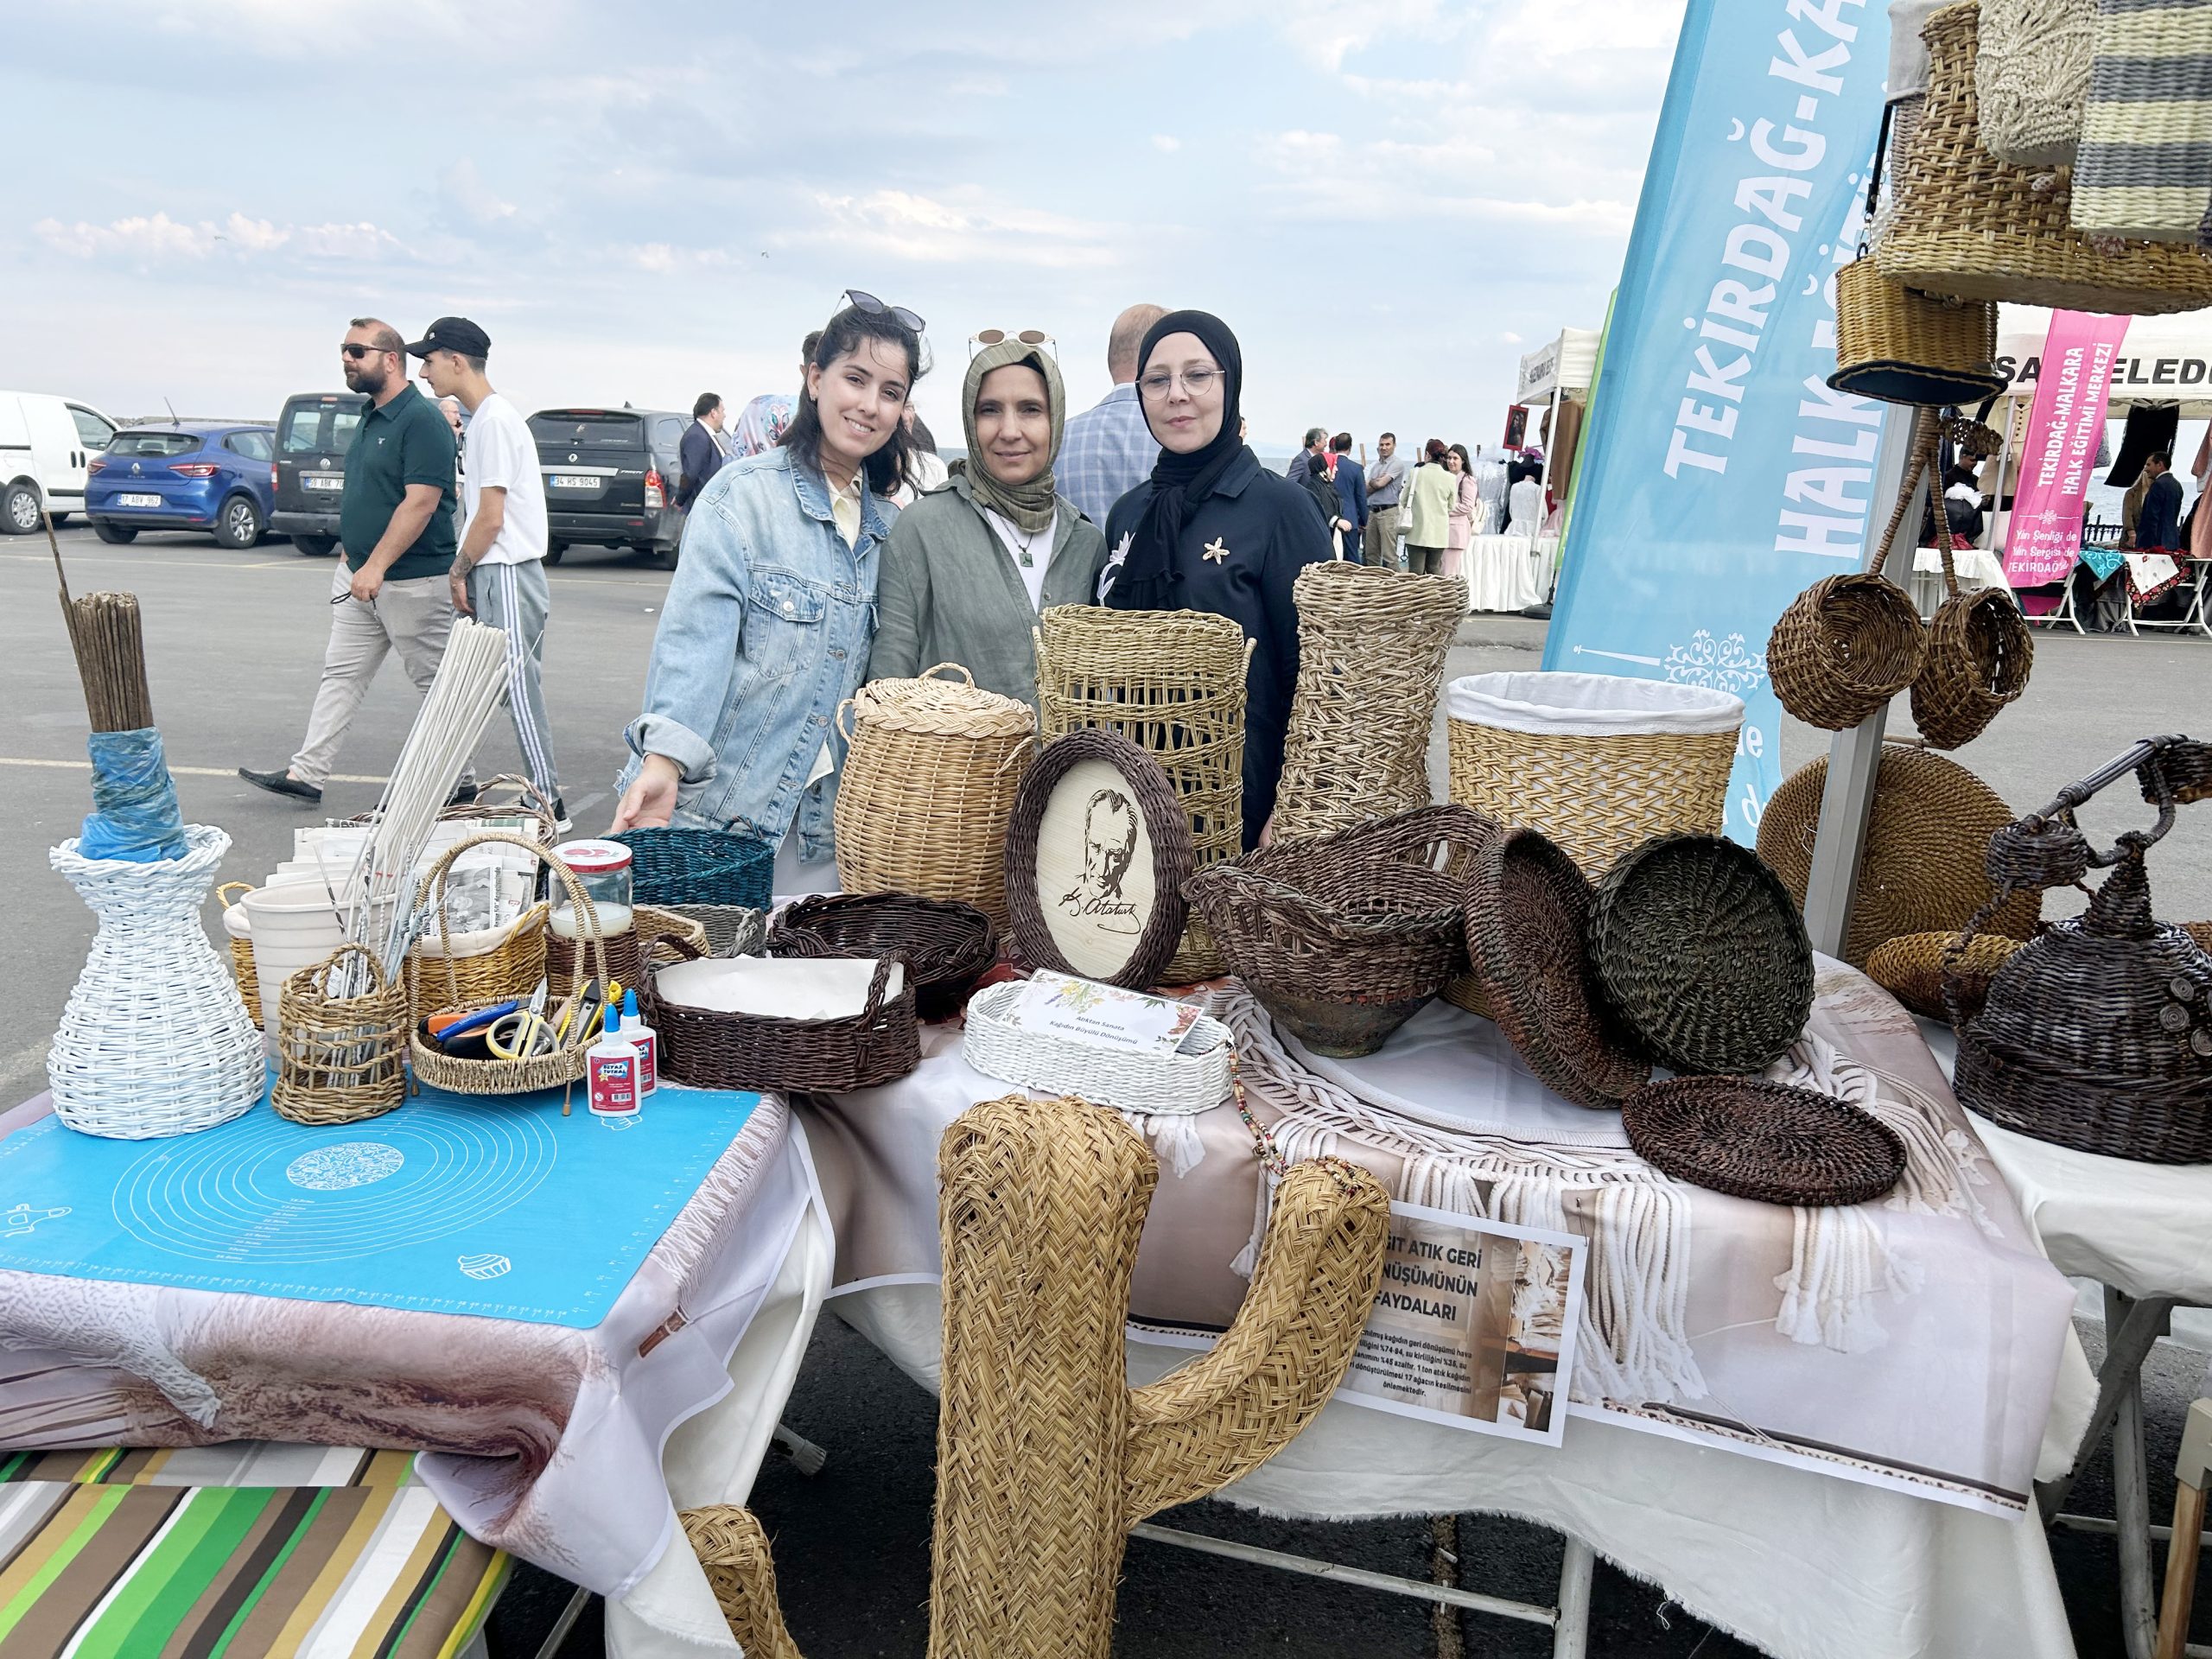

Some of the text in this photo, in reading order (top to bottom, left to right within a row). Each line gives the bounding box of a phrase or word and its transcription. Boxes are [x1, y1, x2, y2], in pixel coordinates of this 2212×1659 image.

[2037, 347, 2084, 487] TEKİRDAĞ-MALKARA
[2061, 342, 2113, 495] HALK EĞİTİMİ MERKEZİ
[1774, 373, 1884, 560] HALK
[555, 476, 564, 485] 34
[579, 477, 598, 486] 9045
[2066, 531, 2077, 541] de
[2030, 546, 2061, 560] Sergisi
[1408, 1240, 1444, 1262] ATIK
[1446, 1248, 1483, 1269] GERİ
[1421, 1365, 1433, 1375] ton
